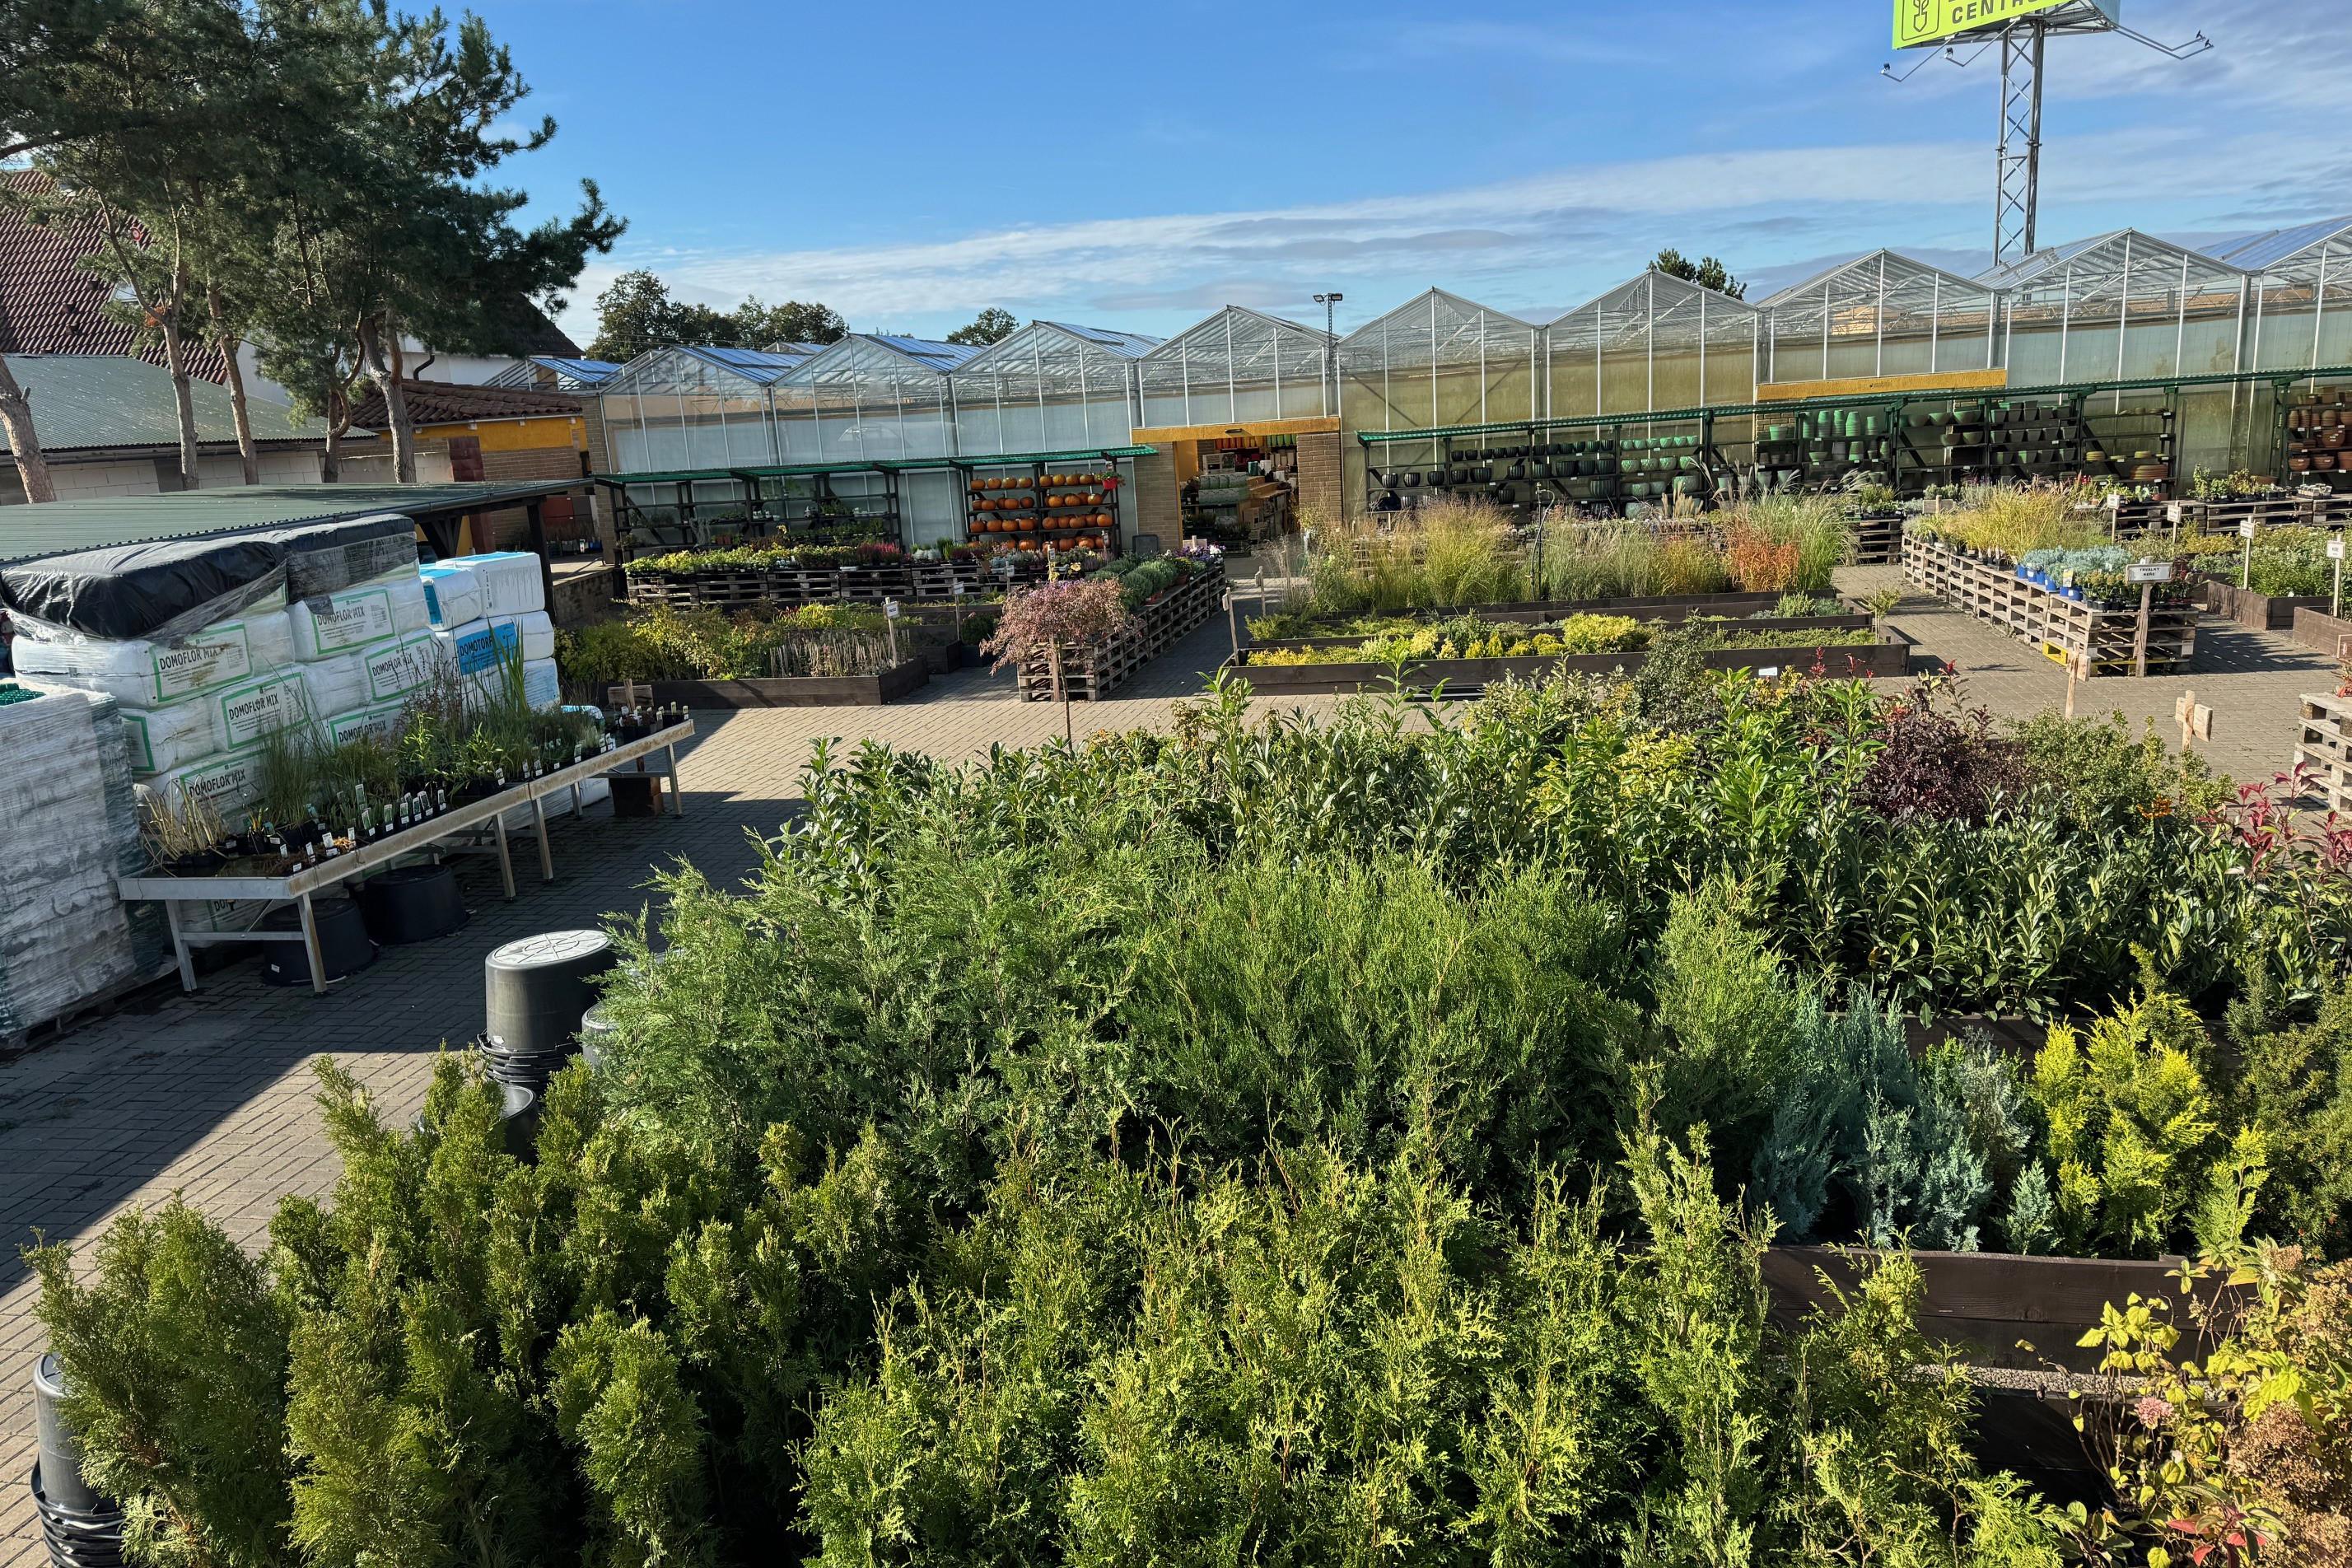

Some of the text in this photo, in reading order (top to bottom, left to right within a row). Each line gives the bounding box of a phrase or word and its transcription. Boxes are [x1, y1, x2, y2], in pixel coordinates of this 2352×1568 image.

[317, 609, 352, 625] DOMOFLOR
[353, 606, 365, 618] MIX
[160, 648, 202, 670] DOMOFLOR
[229, 698, 265, 720] DOMOFLOR
[266, 693, 279, 707] MIX
[189, 774, 230, 798] DOMOFLOR
[231, 768, 246, 784] MIX
